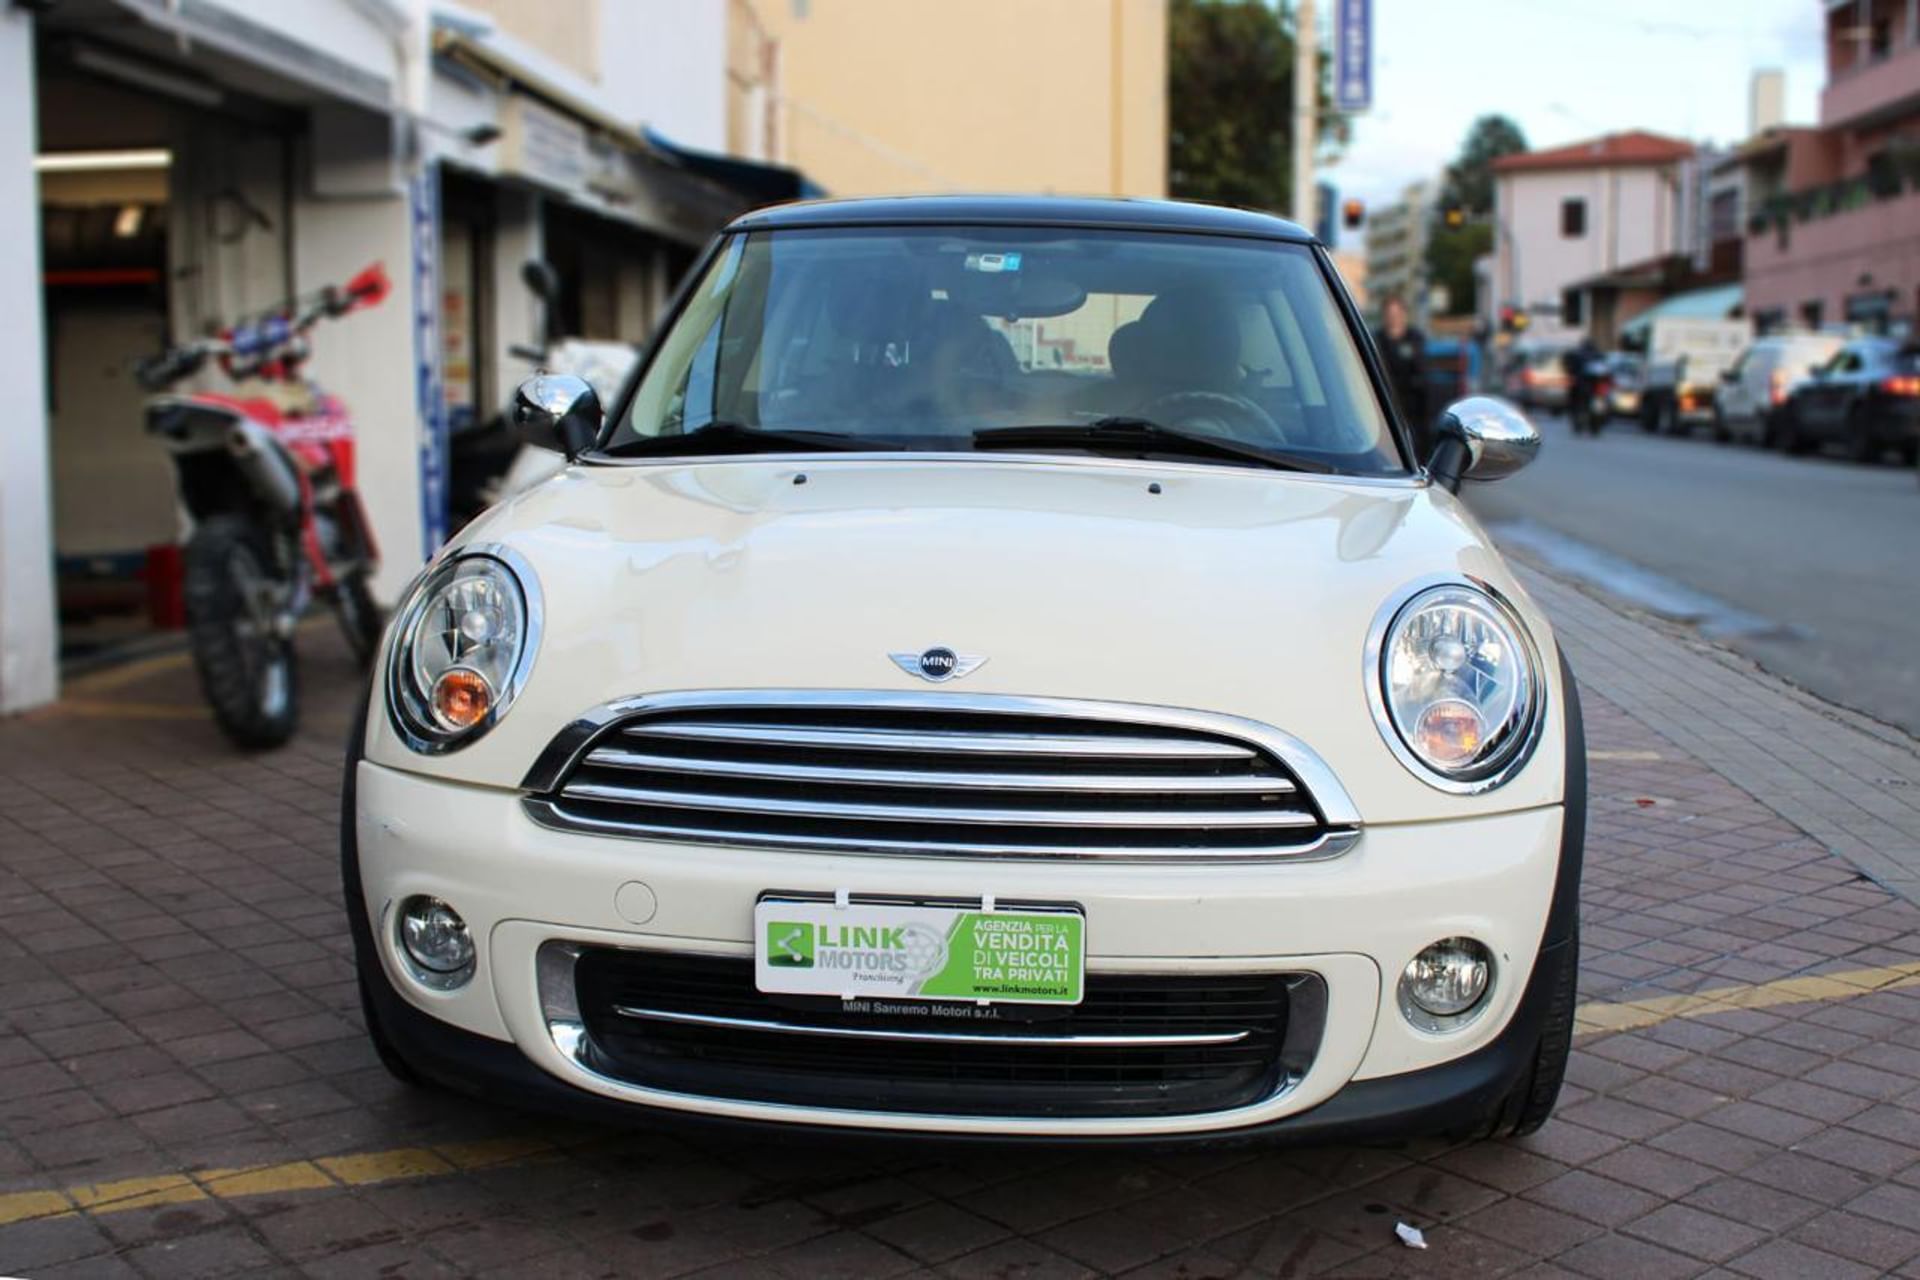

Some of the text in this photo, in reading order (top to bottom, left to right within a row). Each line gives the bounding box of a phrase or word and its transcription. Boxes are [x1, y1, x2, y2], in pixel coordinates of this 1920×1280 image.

[922, 656, 953, 667] MINI
[974, 920, 1032, 932] AGENZIA
[1056, 924, 1069, 934] LA
[819, 925, 905, 949] LINK
[973, 932, 1069, 951] VENDITA
[819, 950, 907, 971] MOTORS
[973, 949, 1068, 968] DI VEICOLI
[974, 966, 1068, 982] TRA PRIVATI
[973, 984, 1068, 996] www.linkmotors.it
[843, 1001, 999, 1019] MINI Sanremo Motori s.r.l.
